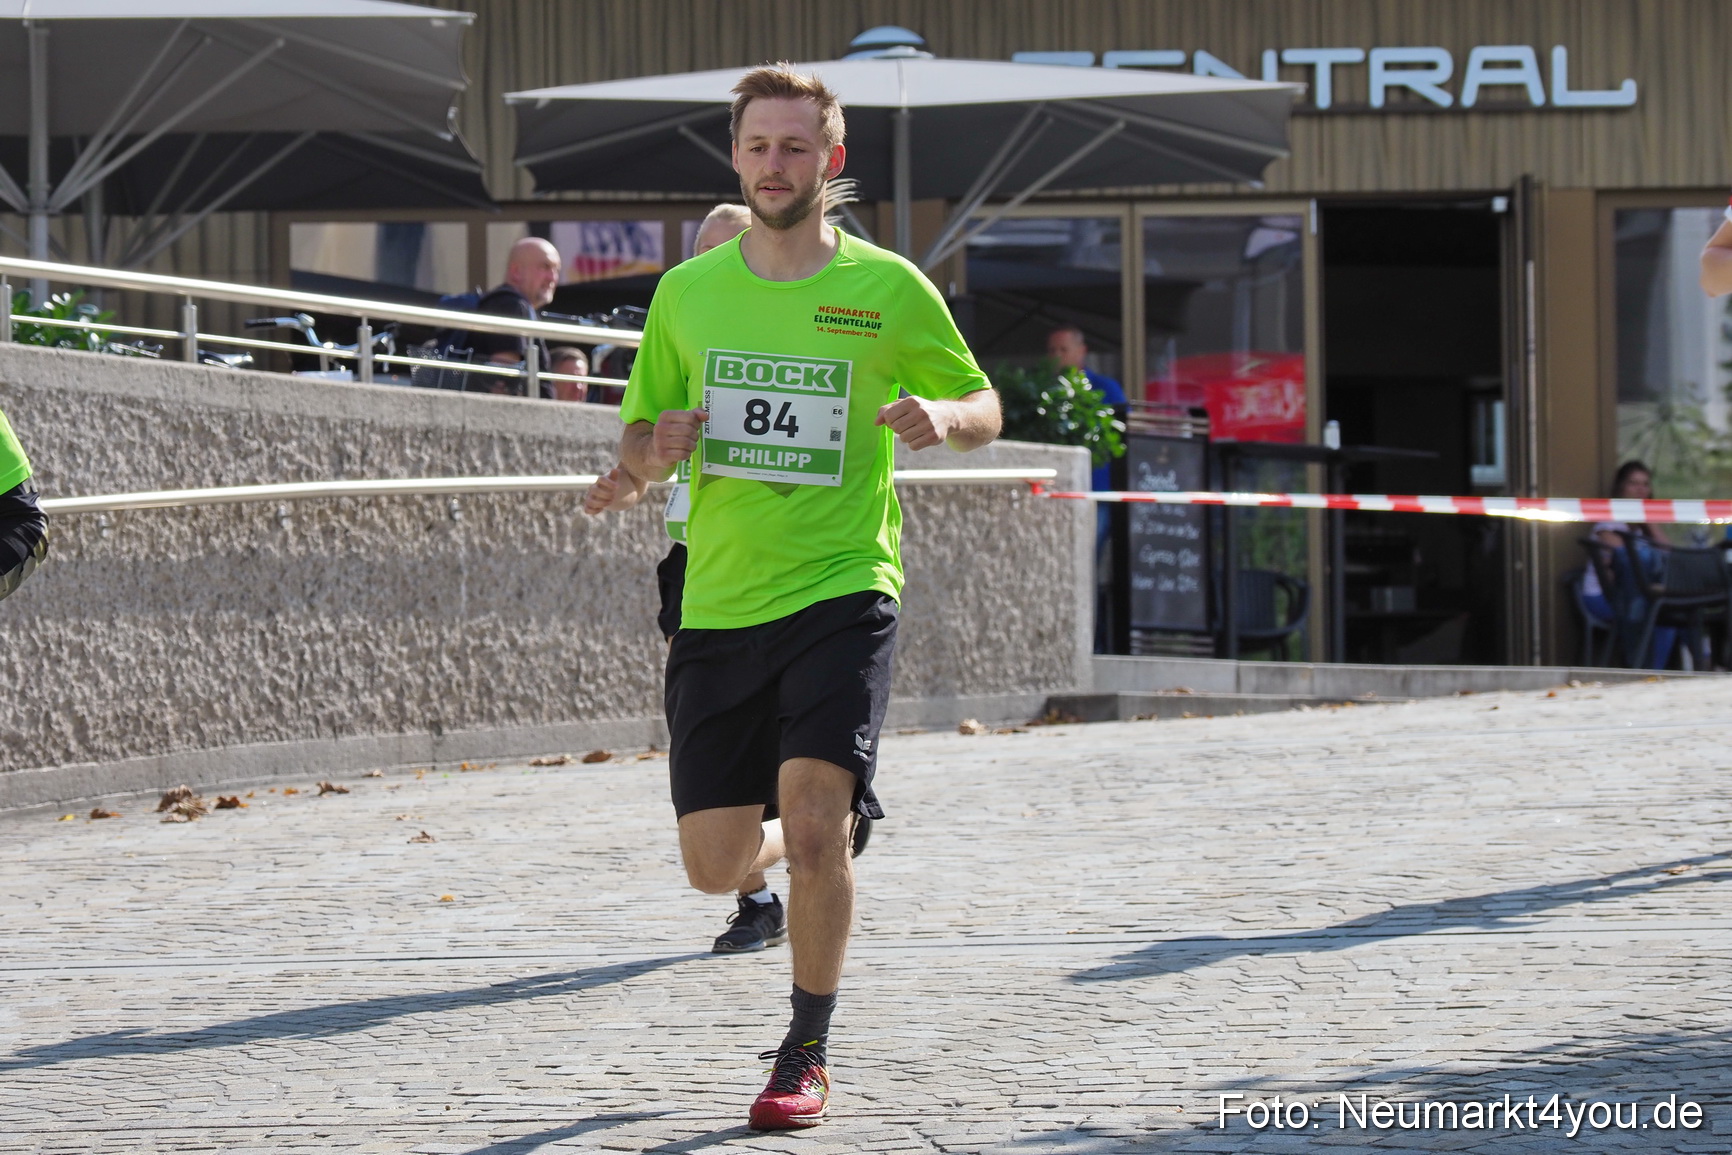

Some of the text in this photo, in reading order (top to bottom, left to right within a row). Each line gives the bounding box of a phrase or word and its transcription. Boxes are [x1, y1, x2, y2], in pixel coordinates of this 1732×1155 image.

[818, 306, 881, 319] NEUMARKTER
[814, 315, 882, 330] ELEMENTELAUF
[827, 327, 863, 336] September
[715, 355, 837, 393] BOCK
[744, 398, 799, 438] 84
[728, 446, 812, 469] PHILIPP
